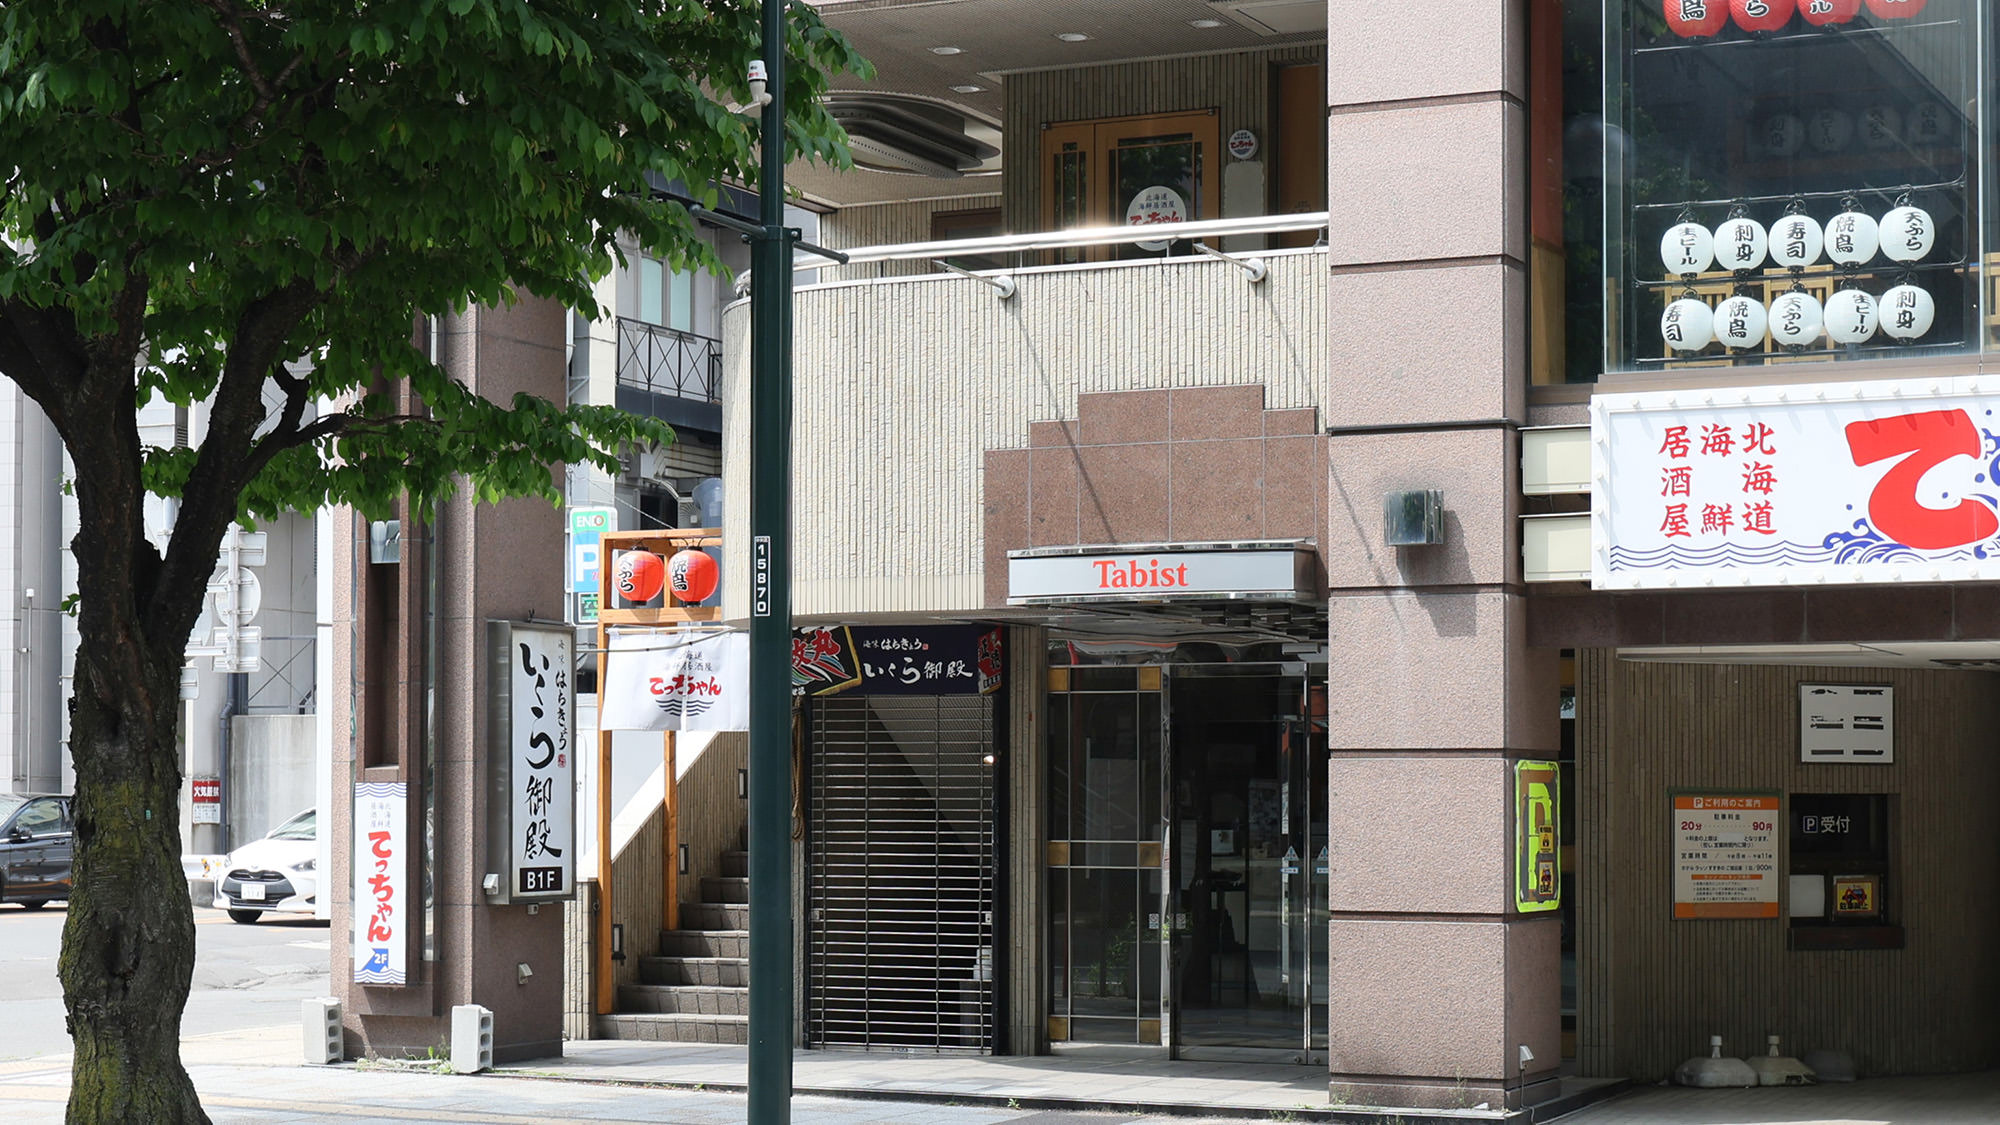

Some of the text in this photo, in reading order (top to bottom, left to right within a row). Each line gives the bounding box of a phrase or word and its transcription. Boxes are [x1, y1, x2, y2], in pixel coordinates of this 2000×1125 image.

[1678, 227, 1697, 266] 生ビール
[1734, 224, 1754, 261] 刺身
[1786, 222, 1806, 259] 寿司
[1834, 216, 1854, 254] 焼鳥
[1904, 211, 1924, 251] 天ぷら
[1666, 304, 1684, 342] 寿司
[1728, 301, 1748, 338] 焼鳥
[1782, 297, 1802, 336] 天ぷら
[1852, 294, 1869, 334] 生ビール
[1896, 290, 1916, 329] 刺身
[1658, 425, 1692, 539] 居酒屋
[1700, 423, 1736, 537] 海鮮
[1741, 422, 1778, 536] 北海道
[1844, 408, 2000, 550] て
[757, 544, 766, 612] 15870
[1093, 559, 1189, 588] Tabist
[649, 674, 722, 696] てっちゃん
[863, 657, 974, 684] いくら御殿
[520, 642, 562, 860] いくら御殿
[1681, 821, 1702, 831] 20分
[1752, 822, 1773, 831] 90円
[1821, 816, 1850, 833] 受付
[368, 831, 394, 942] てっちゃん
[527, 870, 555, 890] B1F
[374, 954, 388, 964] 2F
